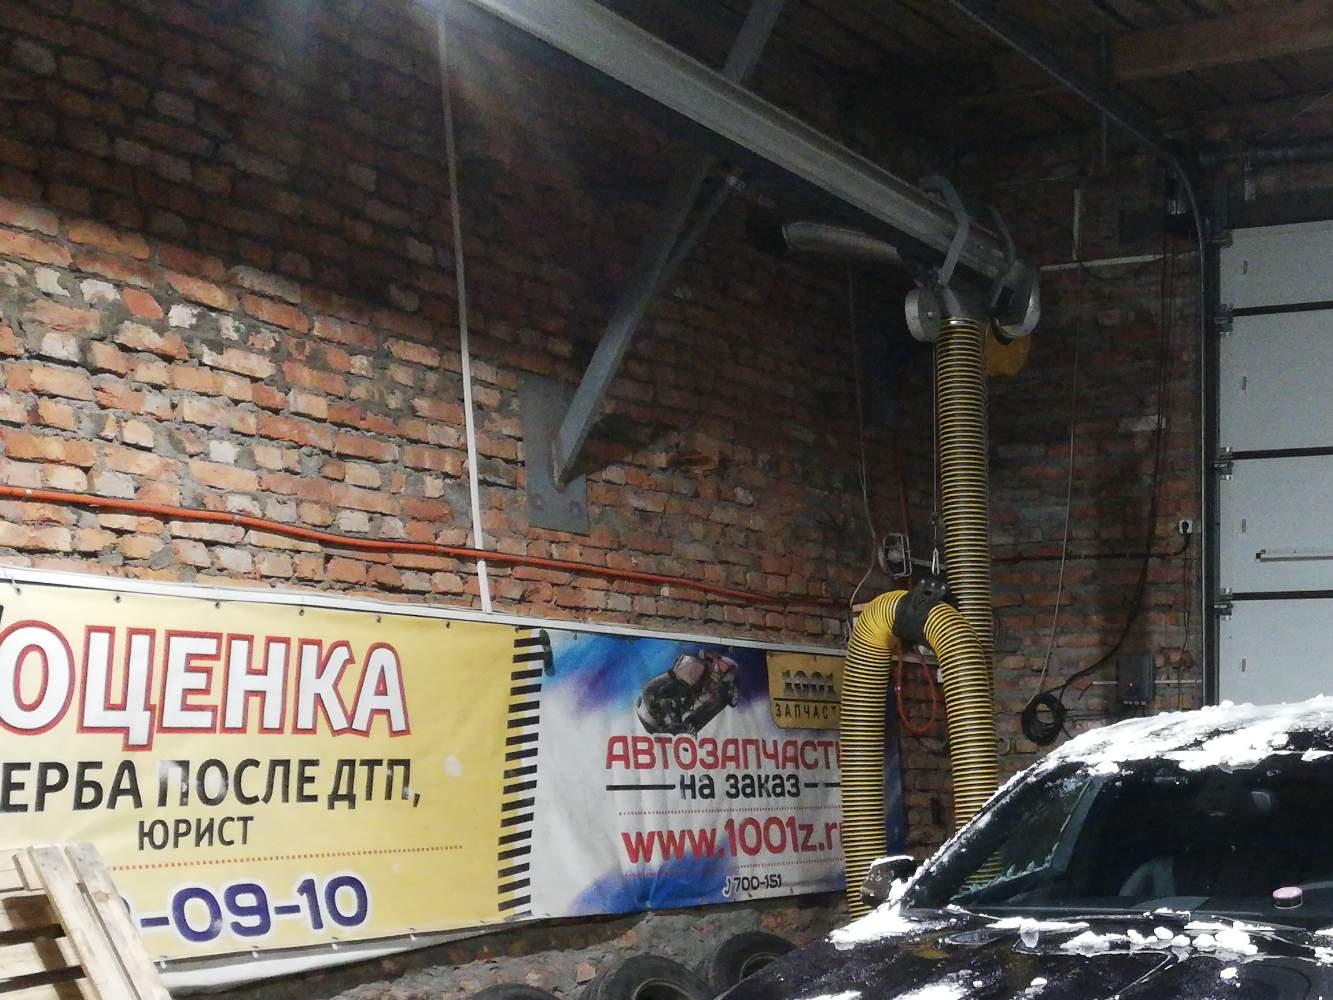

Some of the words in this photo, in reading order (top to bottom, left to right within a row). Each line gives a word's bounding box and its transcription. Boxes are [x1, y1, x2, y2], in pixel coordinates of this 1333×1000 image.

[0, 619, 411, 752] ОЦЕНКА
[605, 735, 842, 770] АВТОЗАПЧАСТ
[157, 758, 321, 807] ПОСЛЕ
[327, 757, 421, 811] ДТП,
[680, 773, 716, 800] на
[725, 774, 801, 798] заказ
[137, 816, 254, 851] ЮРИСТ
[621, 816, 842, 864] www.1001z.r
[734, 874, 783, 892] 700-151
[121, 875, 368, 943] -09-10
